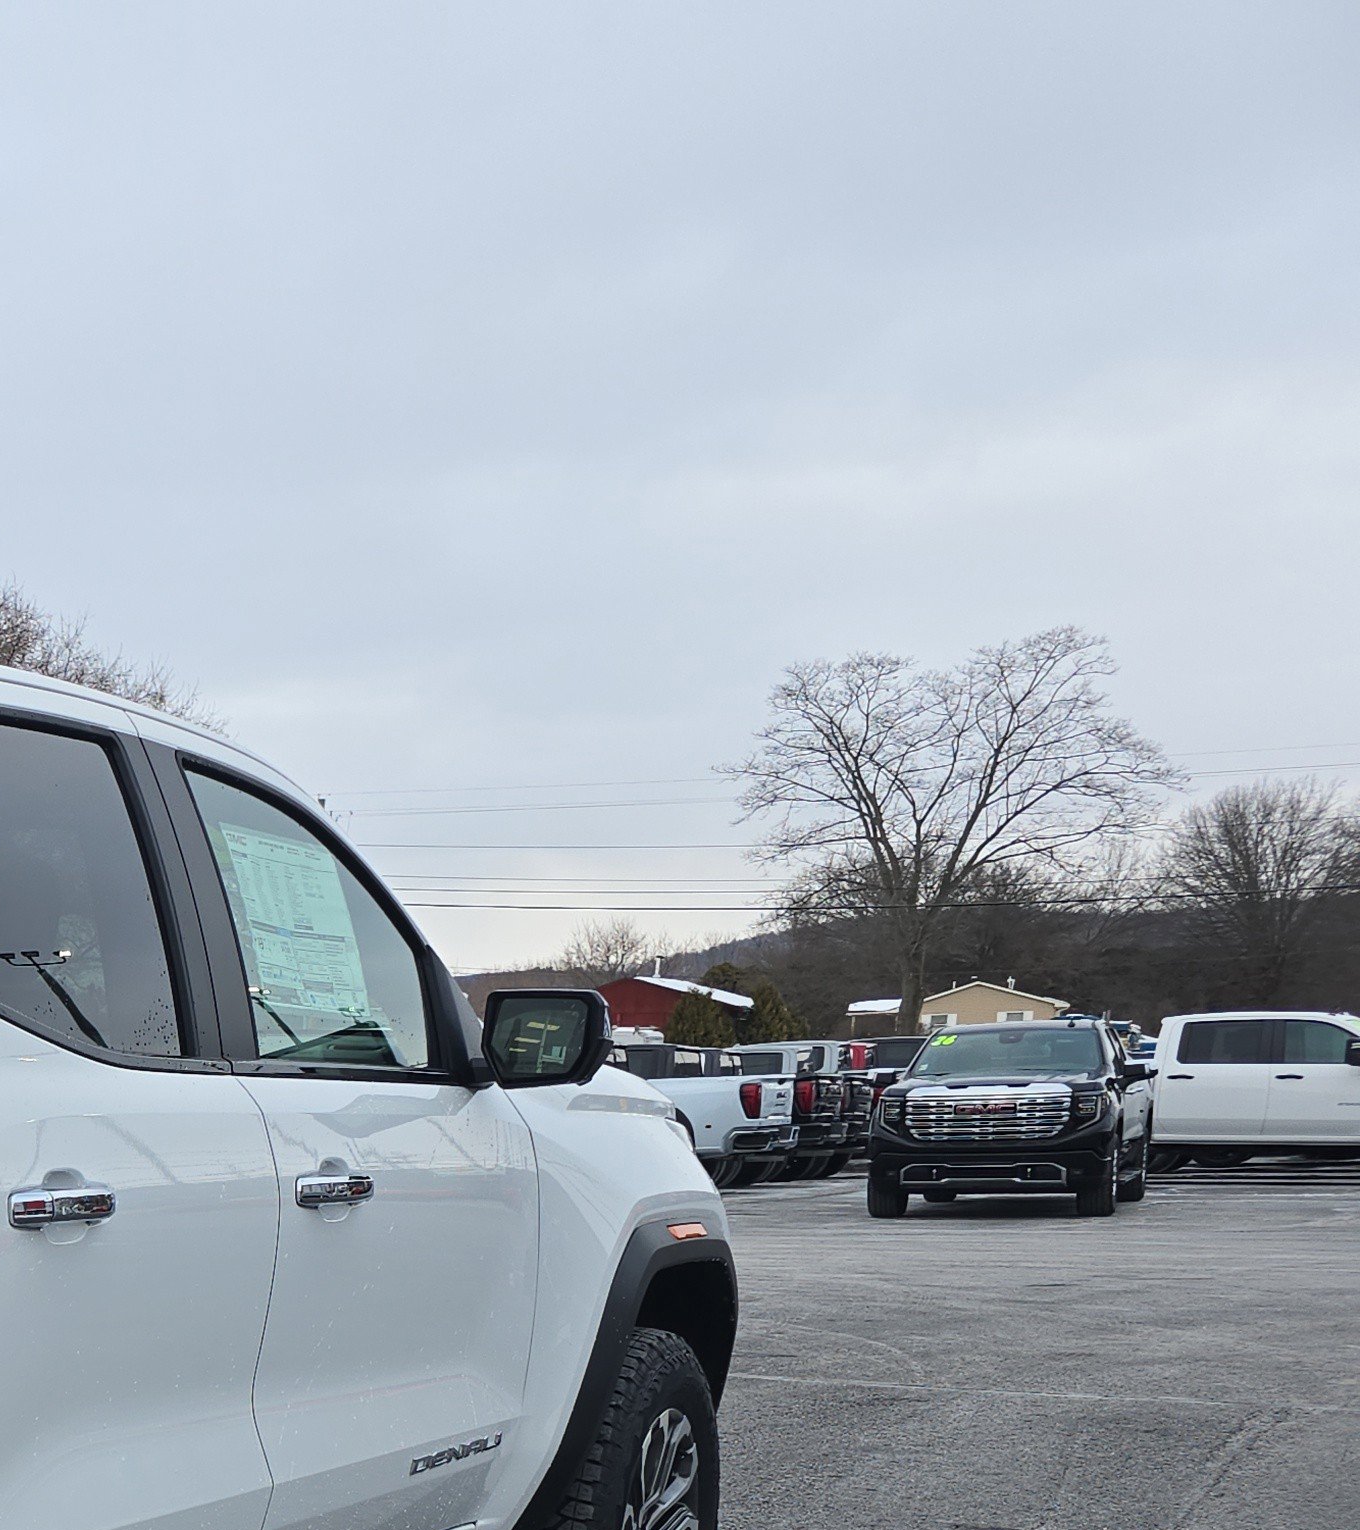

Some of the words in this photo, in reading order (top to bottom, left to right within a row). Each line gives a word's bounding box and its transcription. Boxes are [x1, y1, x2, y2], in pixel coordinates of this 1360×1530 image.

[930, 1033, 958, 1047] 26
[955, 1103, 1018, 1116] GMC
[409, 1430, 503, 1477] DENALI
